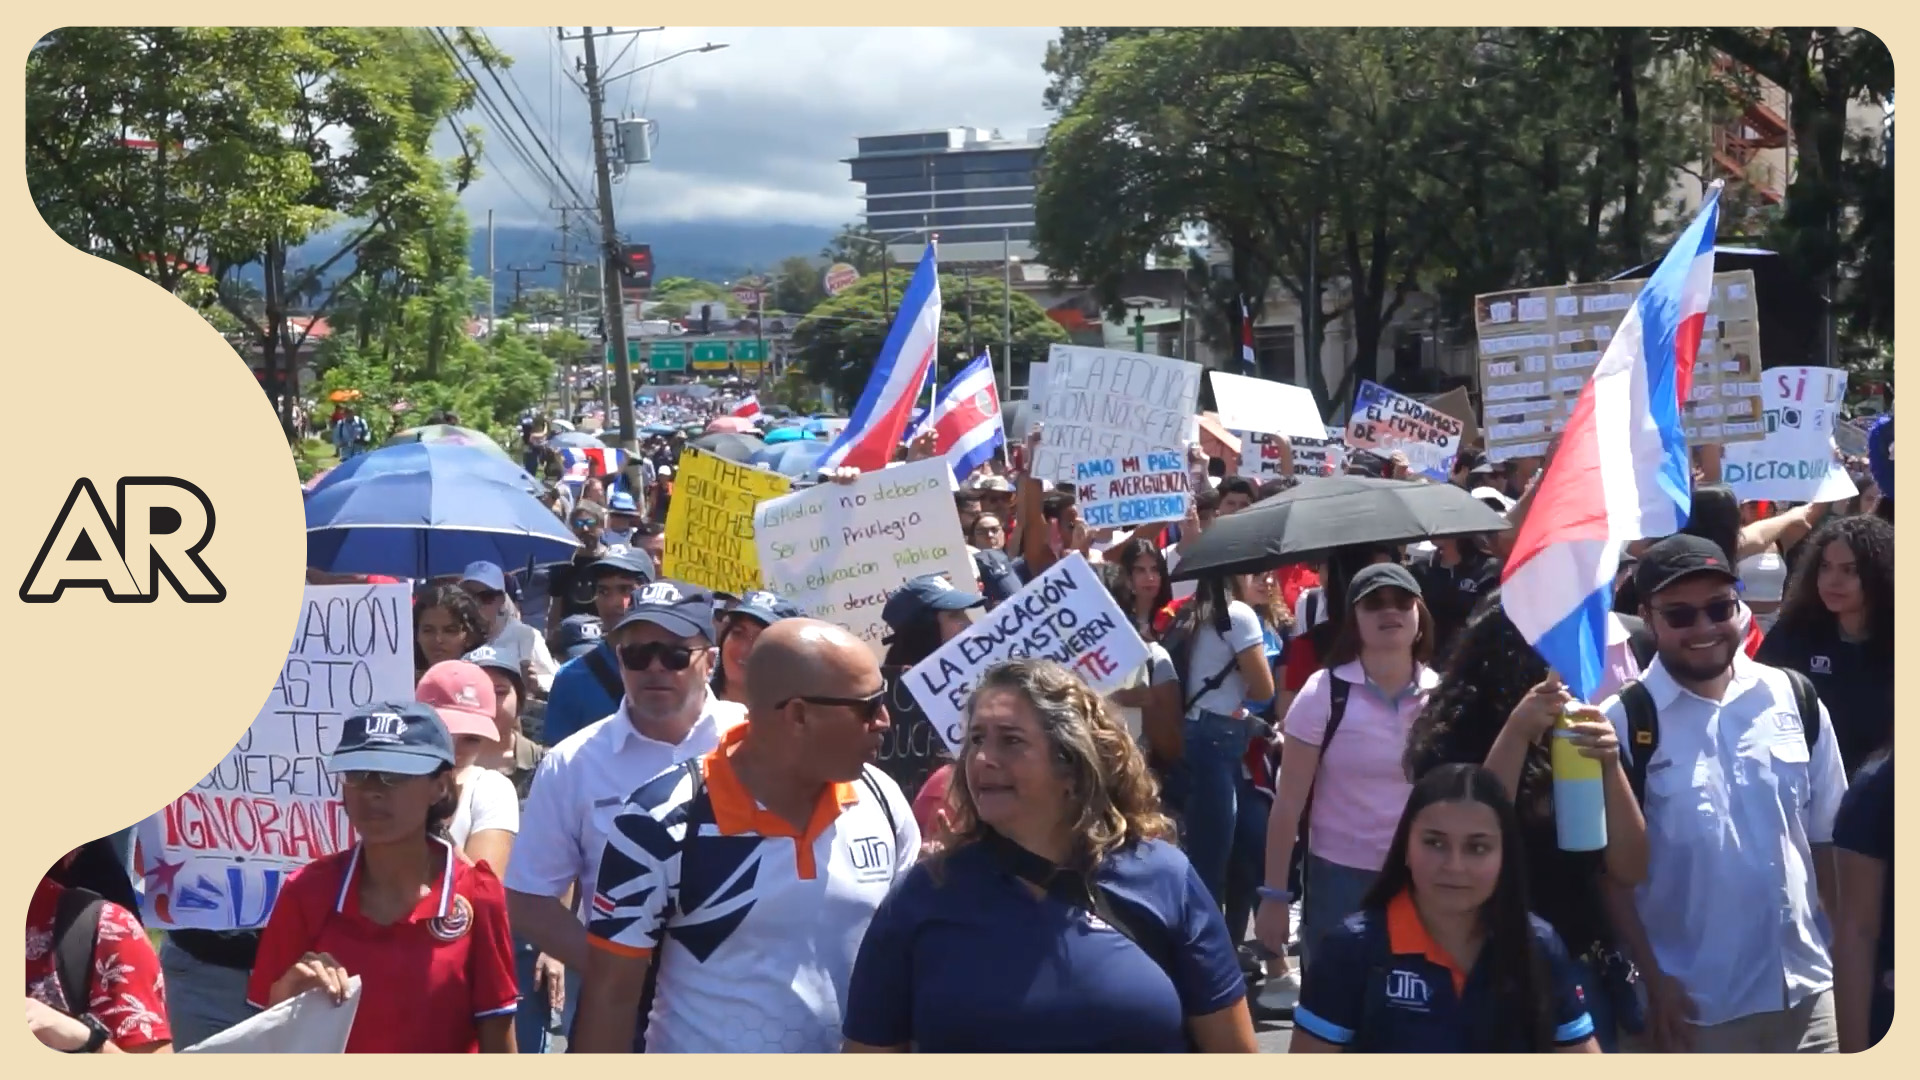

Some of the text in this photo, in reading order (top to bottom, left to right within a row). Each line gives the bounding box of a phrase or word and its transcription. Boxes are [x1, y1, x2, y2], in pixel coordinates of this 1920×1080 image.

[1362, 384, 1460, 436] DEFENDAMOS
[1366, 405, 1449, 448] EL FUTURO
[1354, 423, 1376, 443] DE
[1077, 459, 1114, 480] AMO
[1122, 456, 1141, 473] MI
[840, 495, 867, 509] no
[1079, 483, 1098, 502] ME
[1084, 496, 1185, 525] ESTE GOBIERNO
[289, 585, 399, 657] ACIÓN
[921, 656, 963, 696] LA
[957, 568, 1079, 665] EDUCACIÓN
[1007, 607, 1078, 660] GASTO
